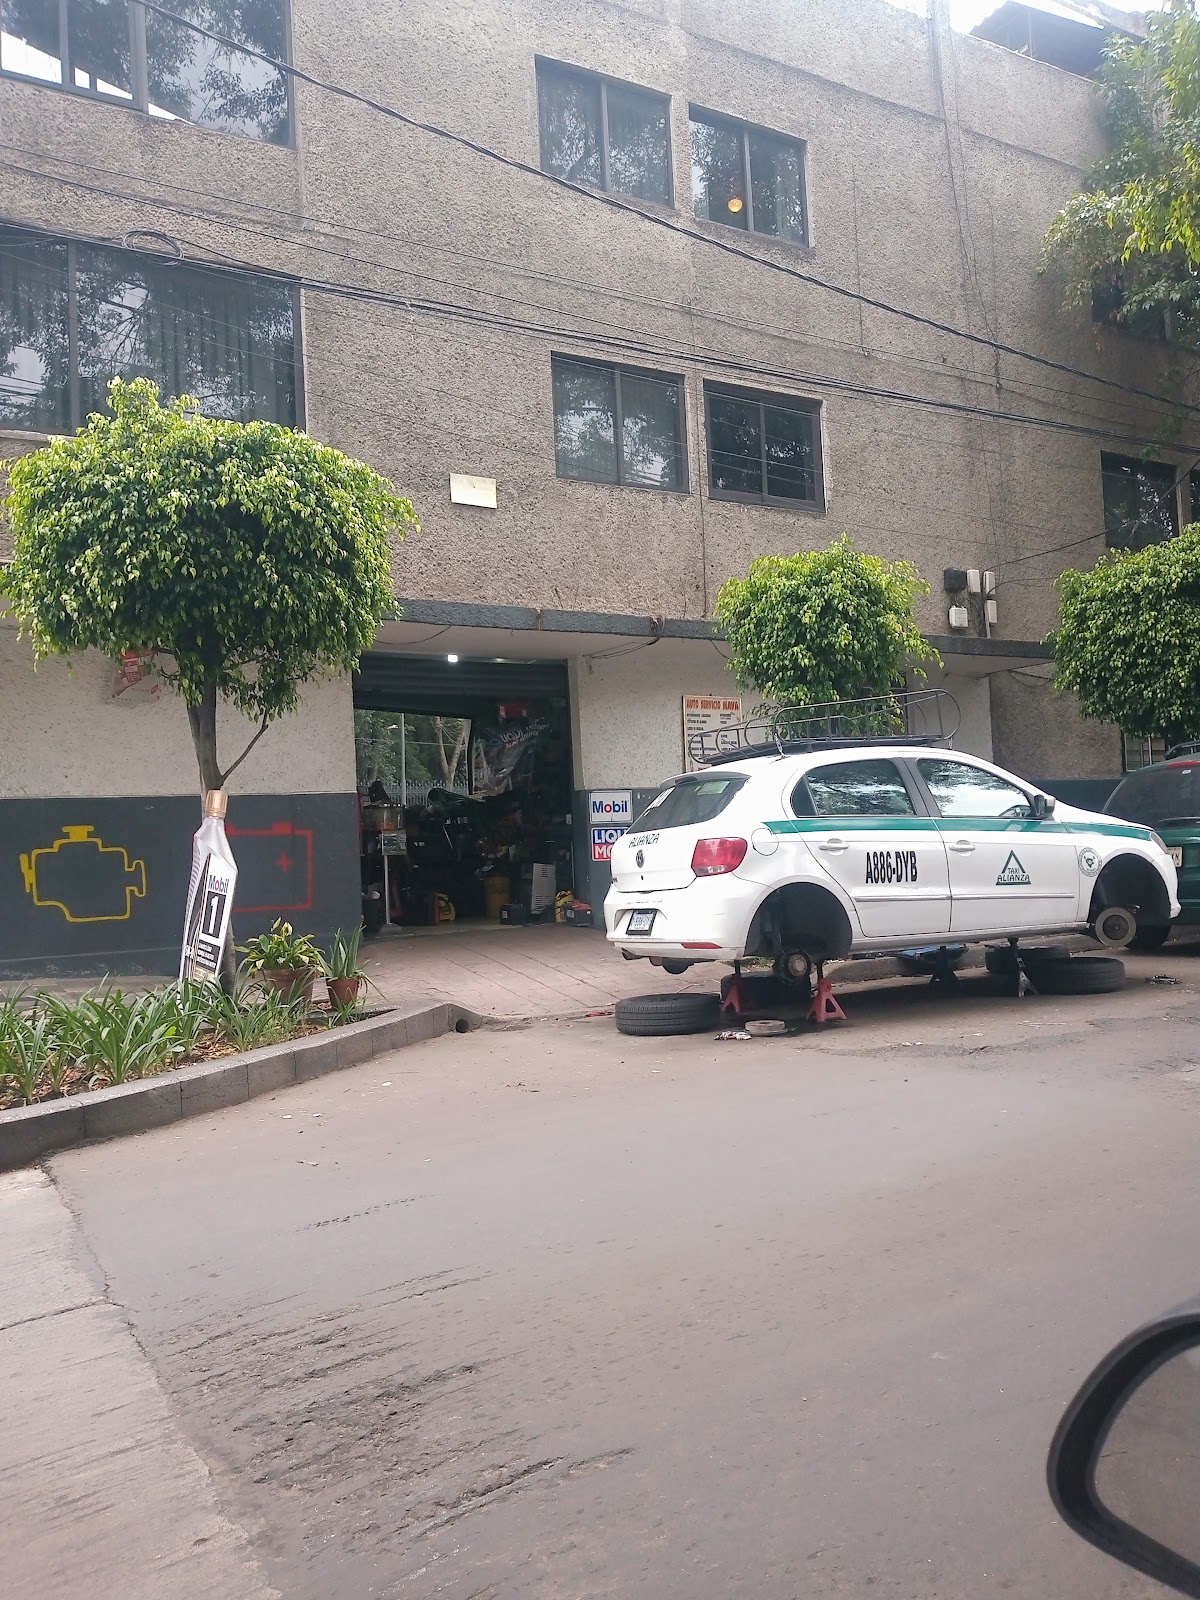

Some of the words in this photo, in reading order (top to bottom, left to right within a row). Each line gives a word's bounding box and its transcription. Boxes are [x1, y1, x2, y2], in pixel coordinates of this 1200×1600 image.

[592, 800, 628, 813] Mobil
[866, 851, 918, 884] A886-DYB
[1007, 867, 1020, 875] TAXI
[208, 874, 229, 893] Mobil
[997, 874, 1030, 882] ALIANZA
[209, 895, 219, 935] 1
